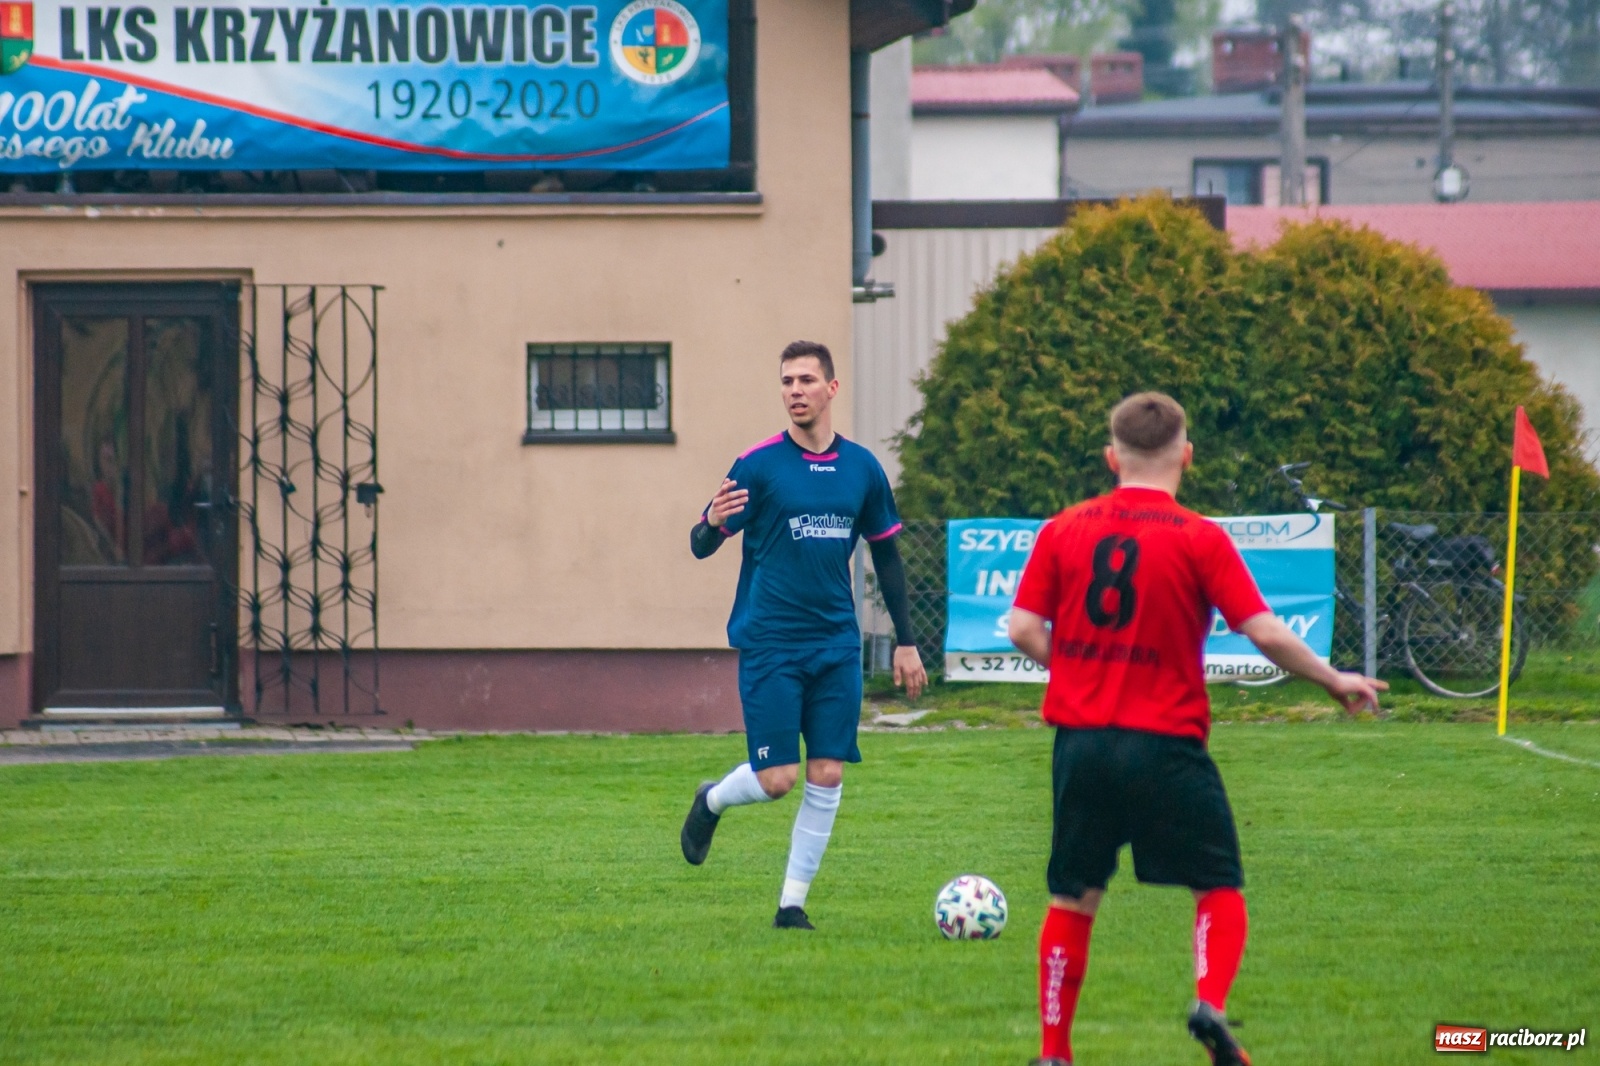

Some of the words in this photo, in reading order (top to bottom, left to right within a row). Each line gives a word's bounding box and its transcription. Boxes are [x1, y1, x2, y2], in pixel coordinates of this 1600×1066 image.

[60, 6, 157, 62] LKS
[174, 0, 598, 63] KRZYŻANOWICE
[367, 79, 599, 119] 1920-2020
[127, 118, 234, 159] Klubu
[959, 528, 1035, 551] SZYB
[975, 569, 1024, 596] IN
[1086, 533, 1140, 632] 8
[981, 656, 1005, 671] 32
[1205, 662, 1289, 677] martco
